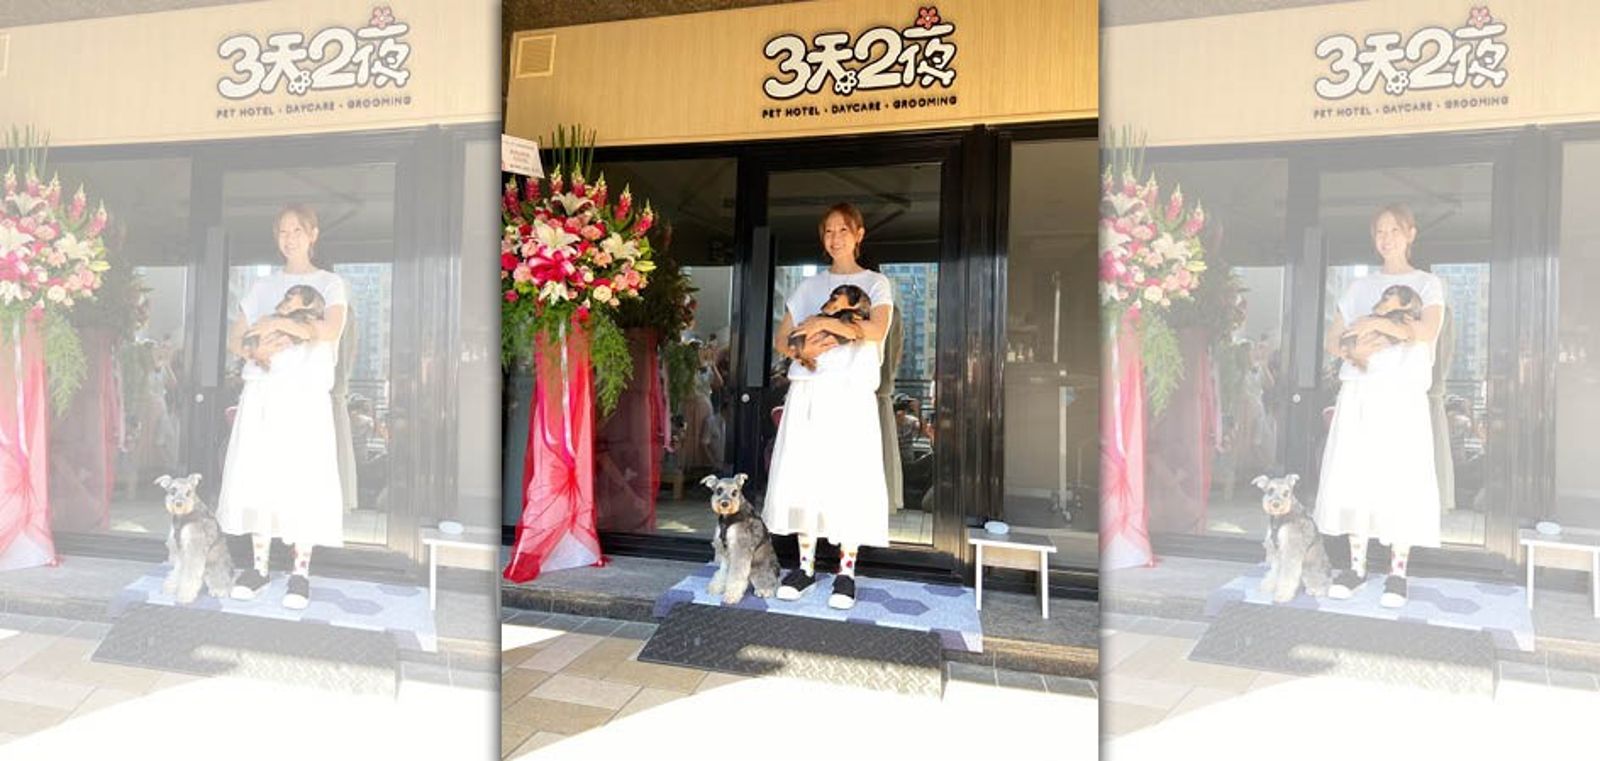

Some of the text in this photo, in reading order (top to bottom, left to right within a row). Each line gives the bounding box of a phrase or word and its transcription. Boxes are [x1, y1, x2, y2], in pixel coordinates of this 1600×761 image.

[763, 6, 957, 100] 3天2夜
[762, 95, 958, 119] PET HOTEL DAYCARE GROOMING
